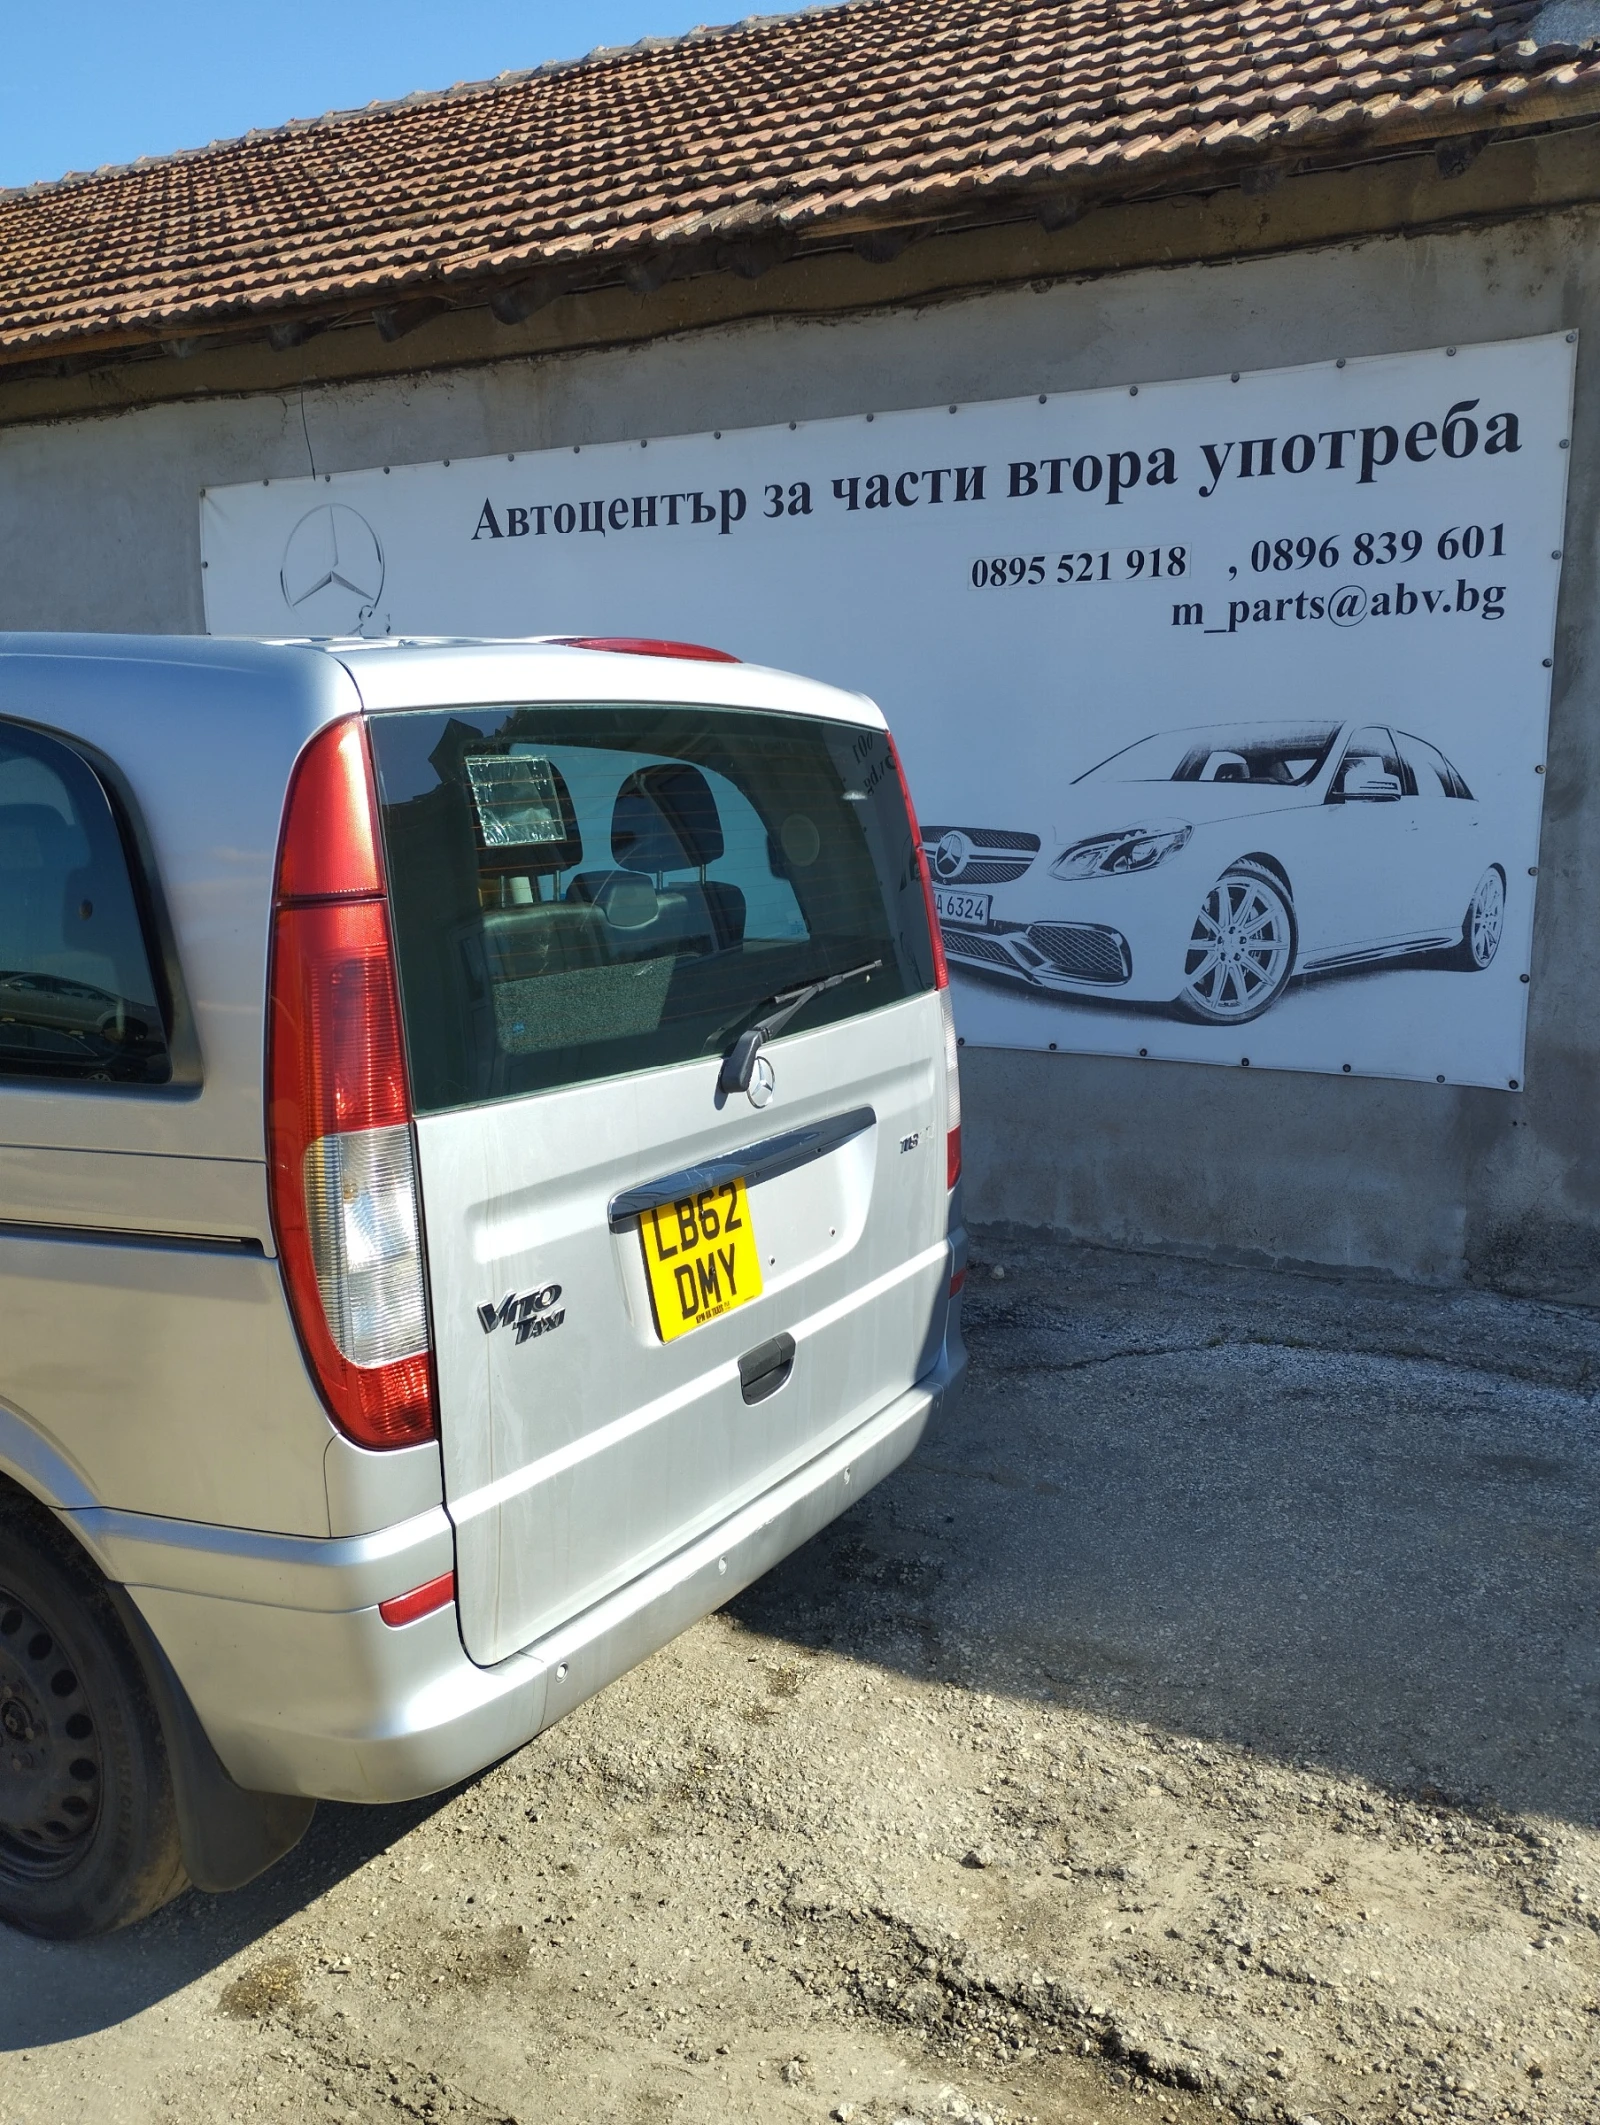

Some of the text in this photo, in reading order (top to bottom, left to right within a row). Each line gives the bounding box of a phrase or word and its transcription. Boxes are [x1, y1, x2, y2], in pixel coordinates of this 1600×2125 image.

[471, 399, 1522, 540] Автоцентър за части втора употреба
[971, 552, 1045, 587] 0895
[1056, 551, 1110, 583] 521
[1126, 546, 1186, 578] 918
[1251, 534, 1340, 572] 0896
[1353, 529, 1423, 566] 839
[1437, 523, 1507, 560] 601
[1171, 579, 1507, 633] m_parts@abv.bg
[947, 896, 984, 920] 6324
[651, 1183, 743, 1261] LB62
[674, 1243, 736, 1321] DMY
